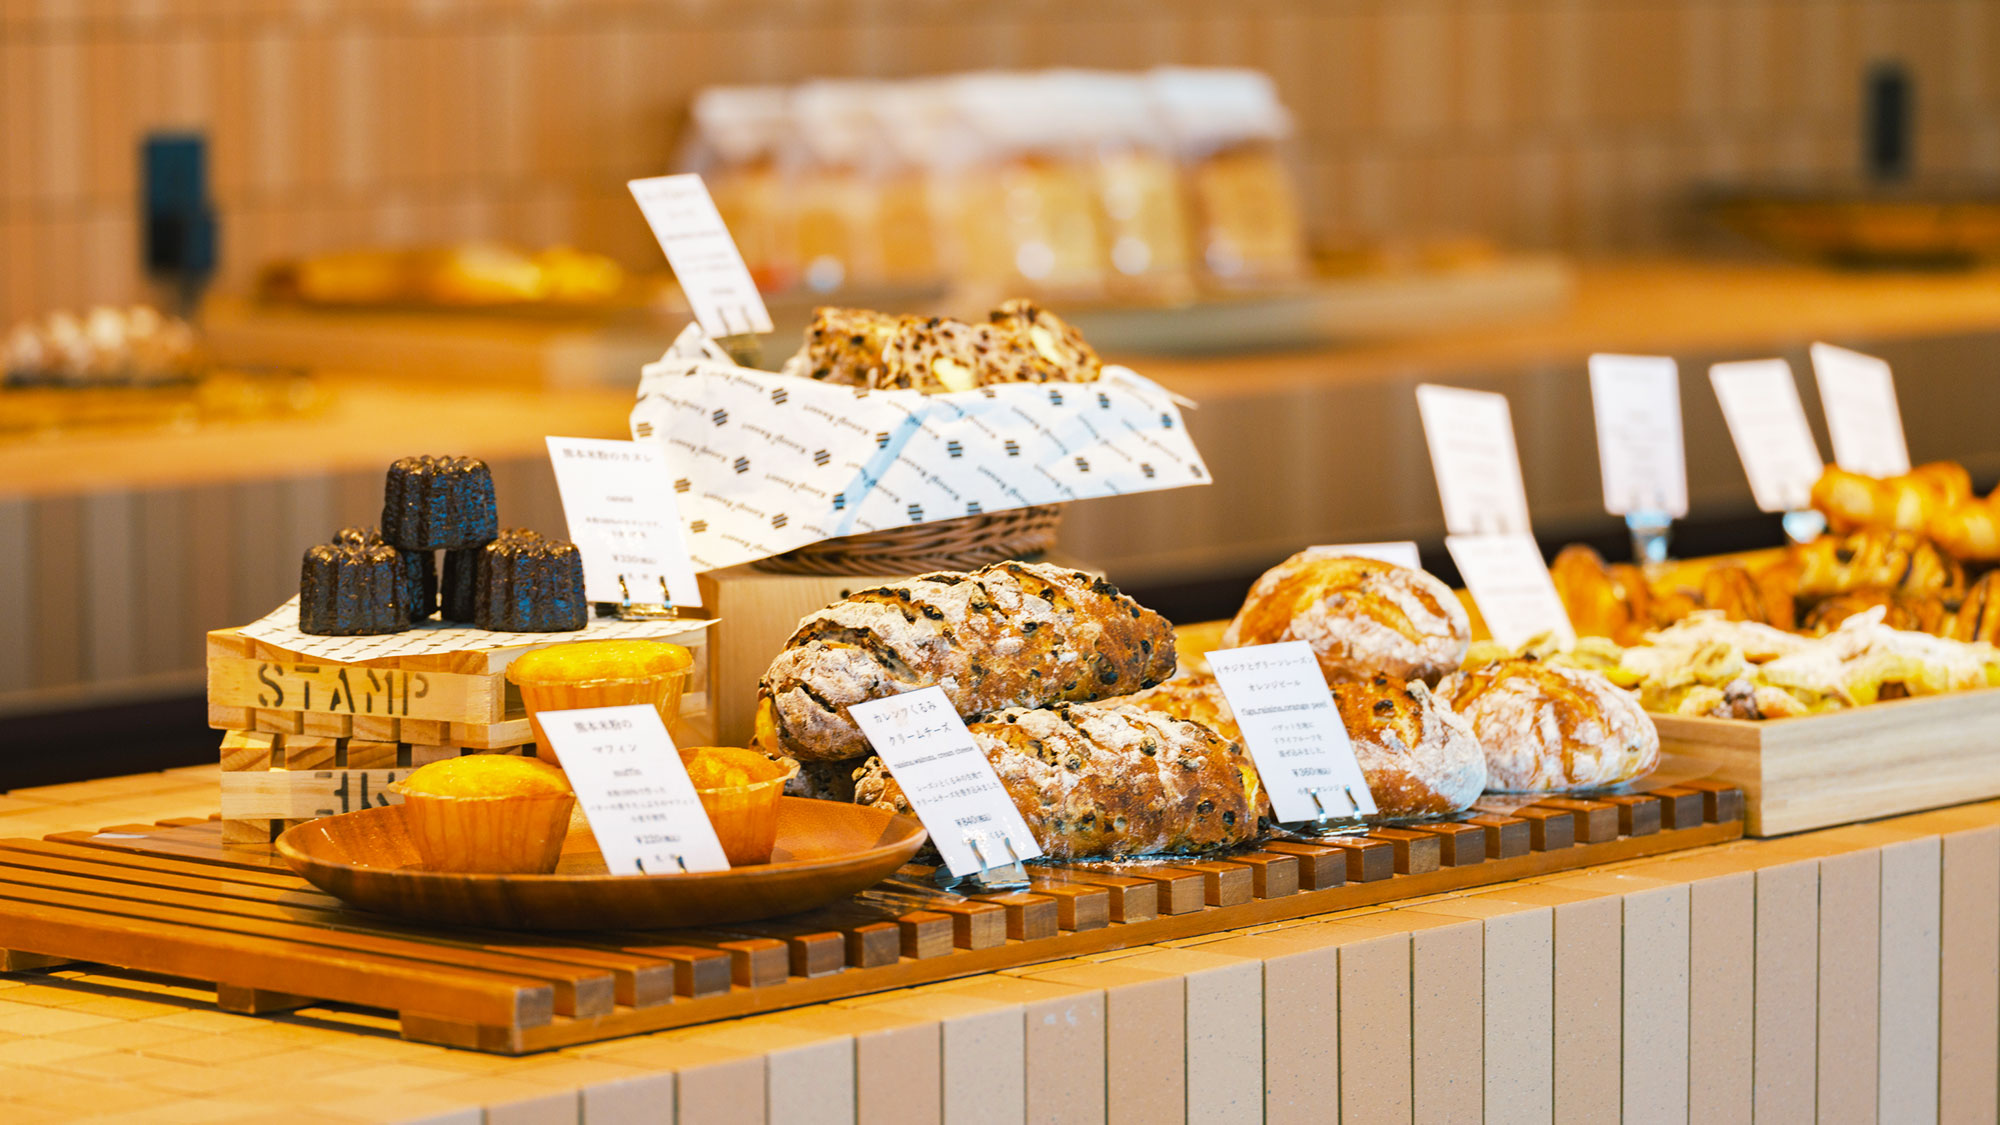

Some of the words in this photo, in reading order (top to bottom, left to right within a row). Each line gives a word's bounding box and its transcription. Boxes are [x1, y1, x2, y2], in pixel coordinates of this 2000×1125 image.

[257, 663, 429, 716] STAMP
[889, 722, 952, 745] クリームチーズ
[592, 744, 637, 754] マフィン
